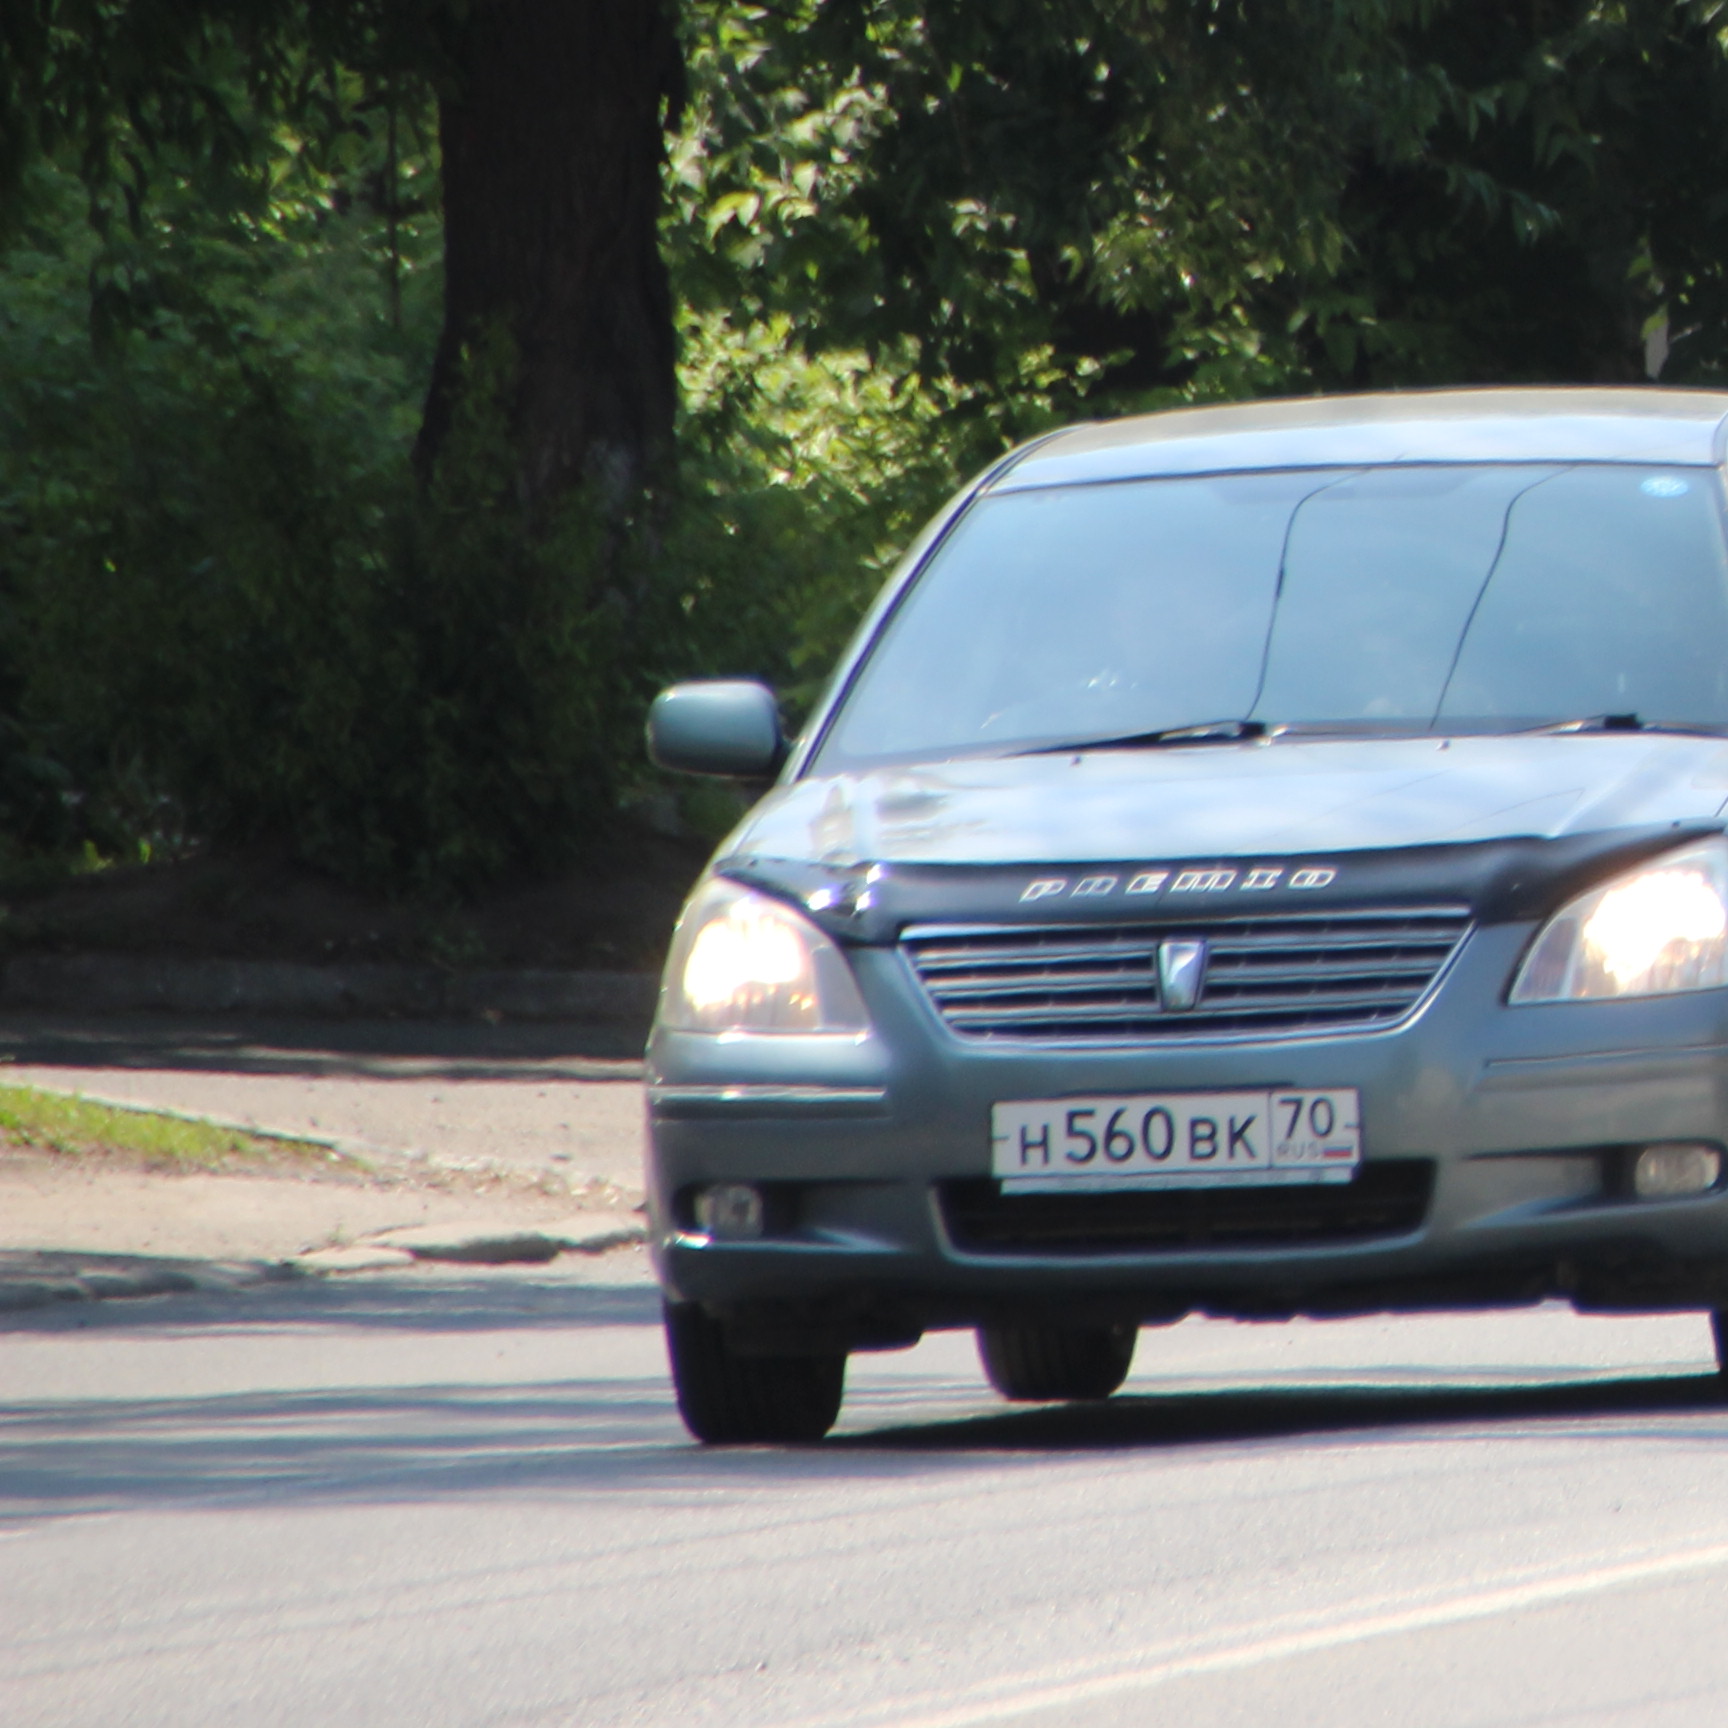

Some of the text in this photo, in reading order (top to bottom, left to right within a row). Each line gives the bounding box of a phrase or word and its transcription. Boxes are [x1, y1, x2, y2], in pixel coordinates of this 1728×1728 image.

[1018, 867, 1338, 903] PREMIO
[1019, 1097, 1336, 1166] Н560ВК 70
